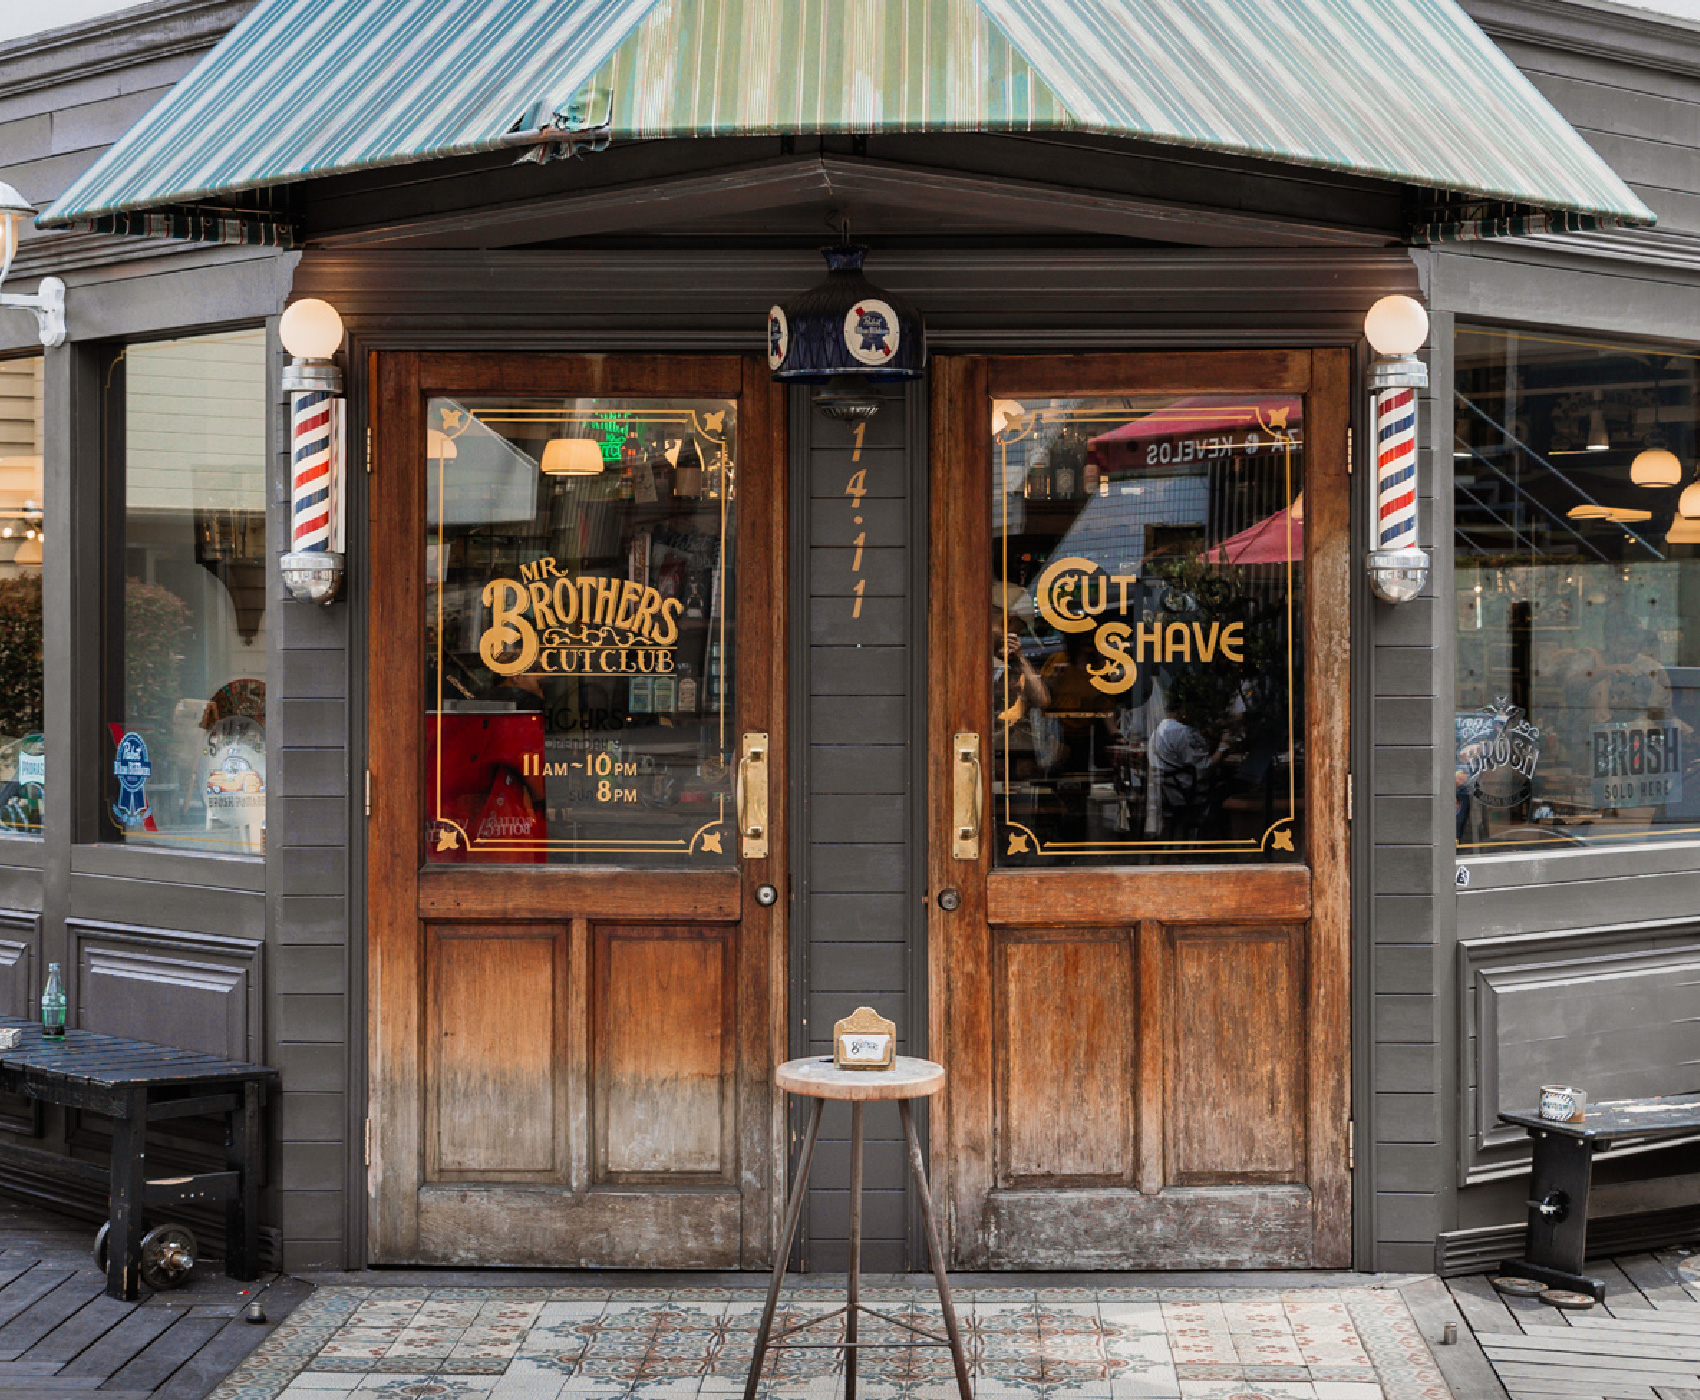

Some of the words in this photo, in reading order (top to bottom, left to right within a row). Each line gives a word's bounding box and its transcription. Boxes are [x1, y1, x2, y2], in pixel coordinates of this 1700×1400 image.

[479, 577, 685, 677] BROTHERS
[1037, 556, 1137, 634] CUT
[540, 649, 596, 673] CUT
[600, 649, 675, 673] CLUB
[1086, 621, 1244, 695] SHAVE
[1604, 783, 1633, 800] SOLD
[1641, 779, 1669, 797] HERE
